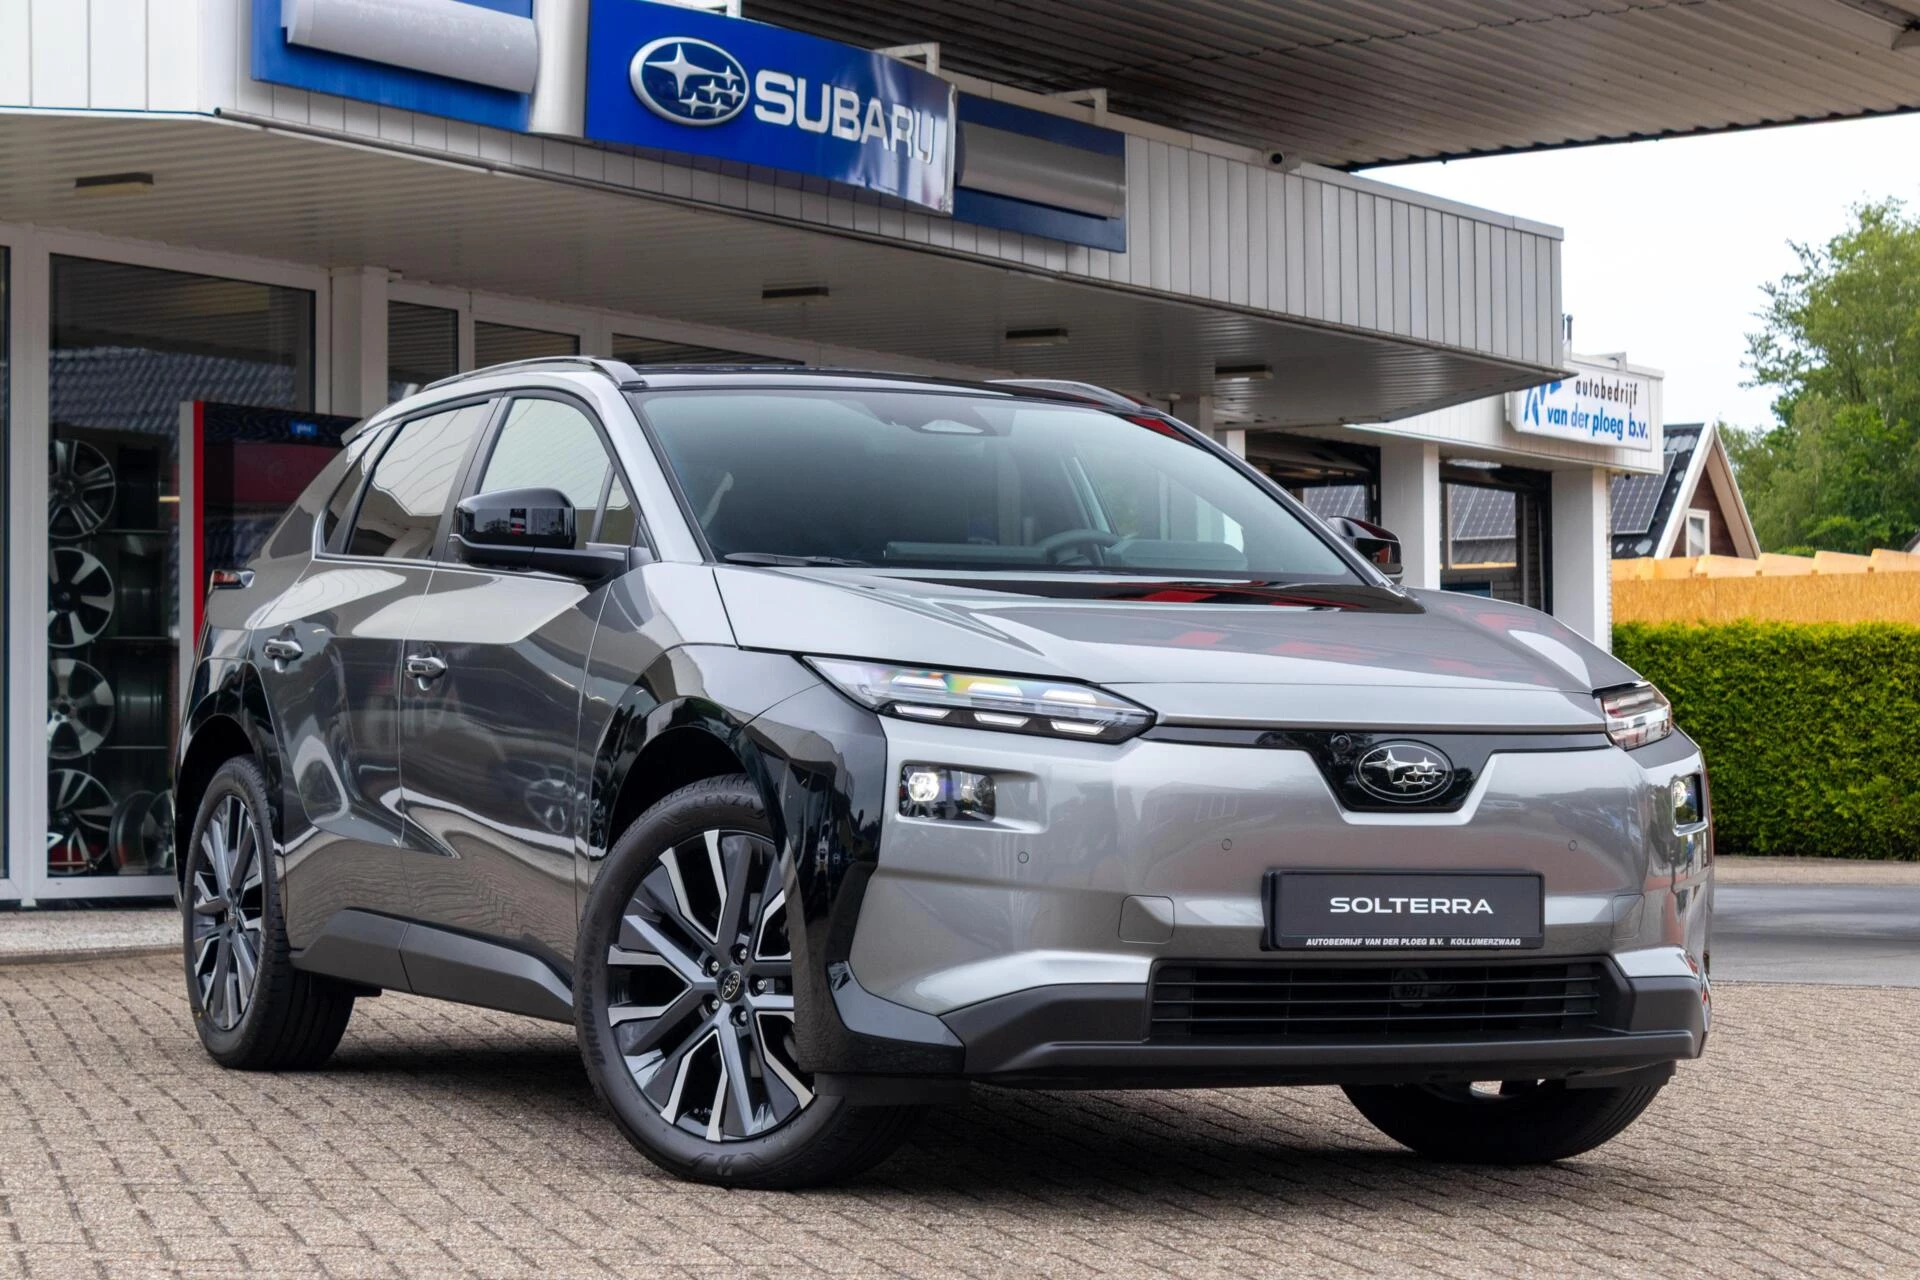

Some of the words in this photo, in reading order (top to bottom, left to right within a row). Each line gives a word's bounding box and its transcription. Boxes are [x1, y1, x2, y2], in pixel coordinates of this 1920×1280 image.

[754, 69, 935, 165] SUBARU
[1575, 376, 1638, 409] autobedrijf
[1547, 406, 1567, 425] van
[1571, 403, 1590, 428] der
[1592, 407, 1624, 441] ploeg
[1628, 412, 1648, 440] b.v.
[1330, 897, 1494, 915] SOLTERRA
[1306, 938, 1363, 946] AUTOBEDRIJF
[1364, 938, 1381, 946] VAN
[1382, 938, 1399, 946] DER
[1400, 938, 1427, 946] PLOEG
[1429, 938, 1444, 946] B.V.
[1450, 938, 1521, 946] KOLLUMERZWAAG
